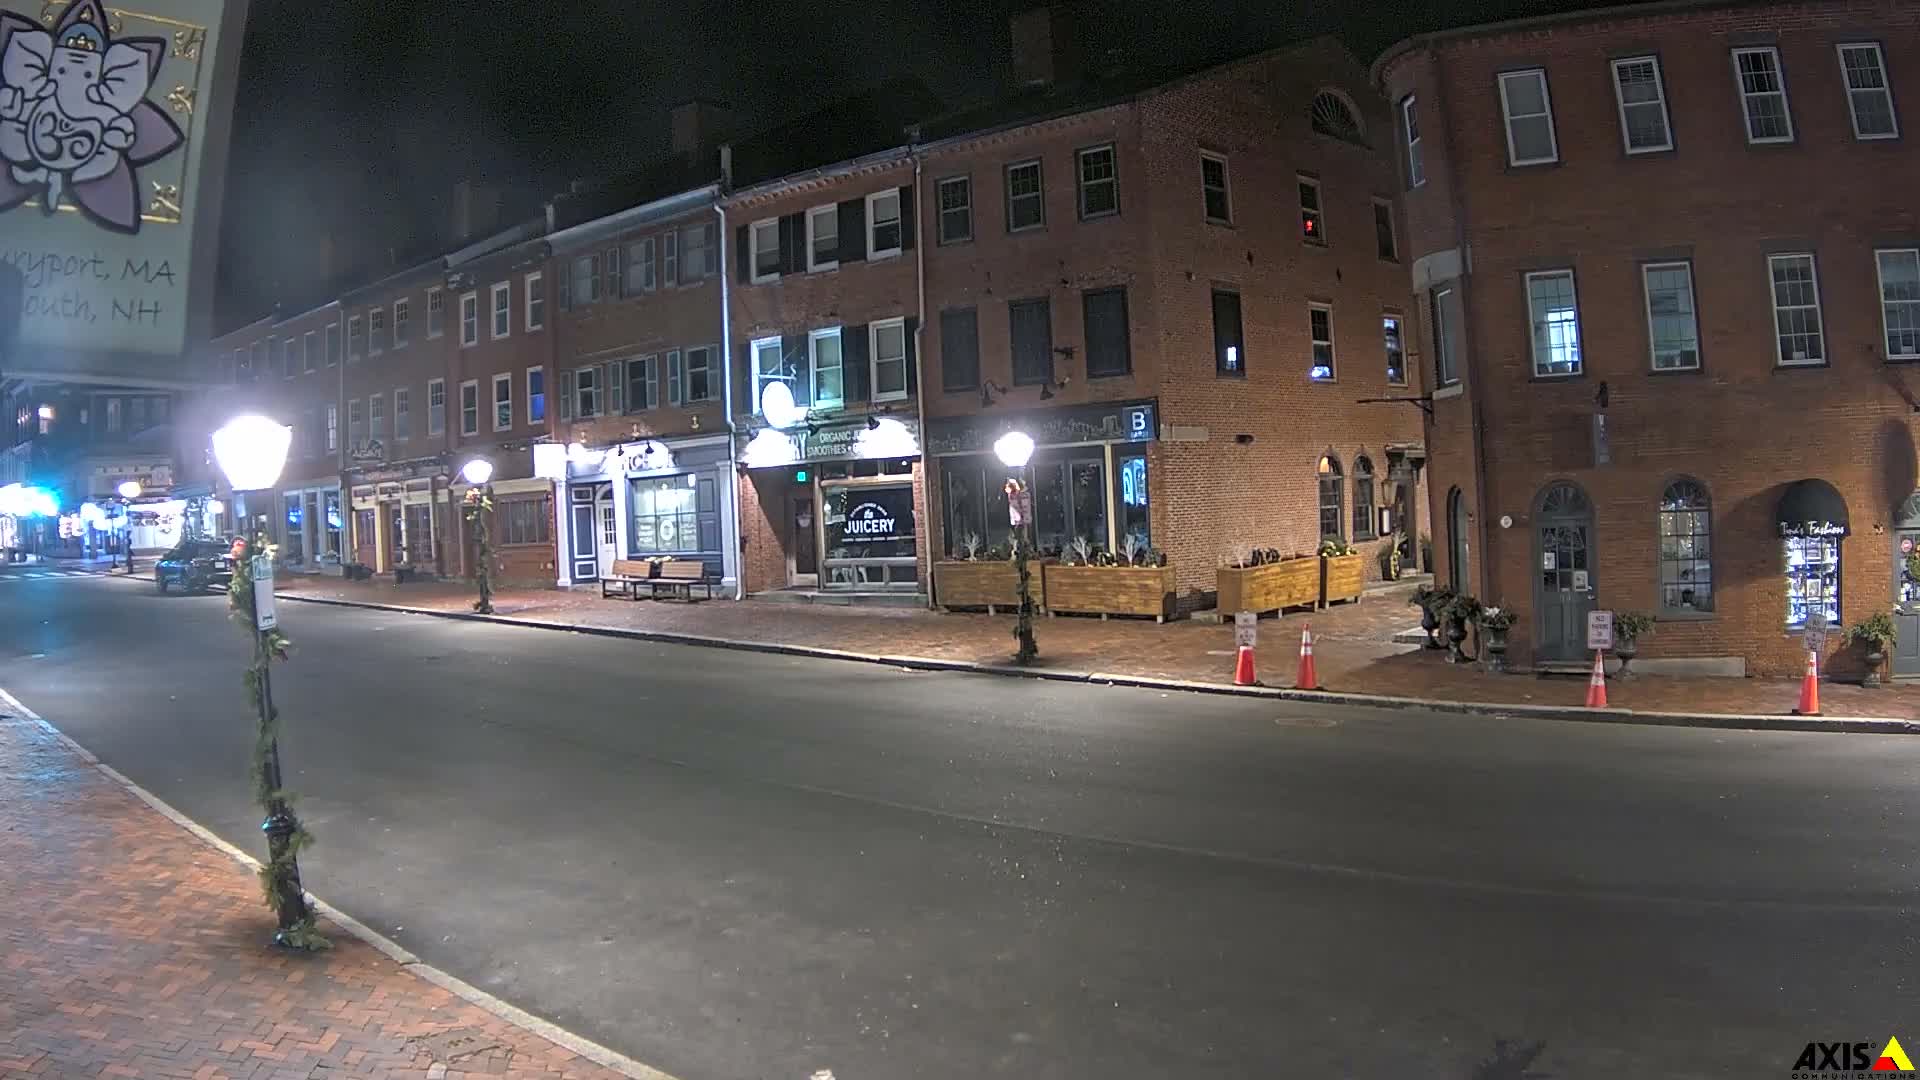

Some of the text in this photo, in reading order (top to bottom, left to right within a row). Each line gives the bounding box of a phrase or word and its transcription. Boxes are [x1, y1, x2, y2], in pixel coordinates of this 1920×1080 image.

[121, 257, 176, 287] MA
[112, 297, 162, 327] NH
[1132, 411, 1146, 430] B
[820, 430, 852, 444] ORGANIC
[807, 443, 847, 457] SMOOTHIES
[844, 518, 895, 534] JUICERY
